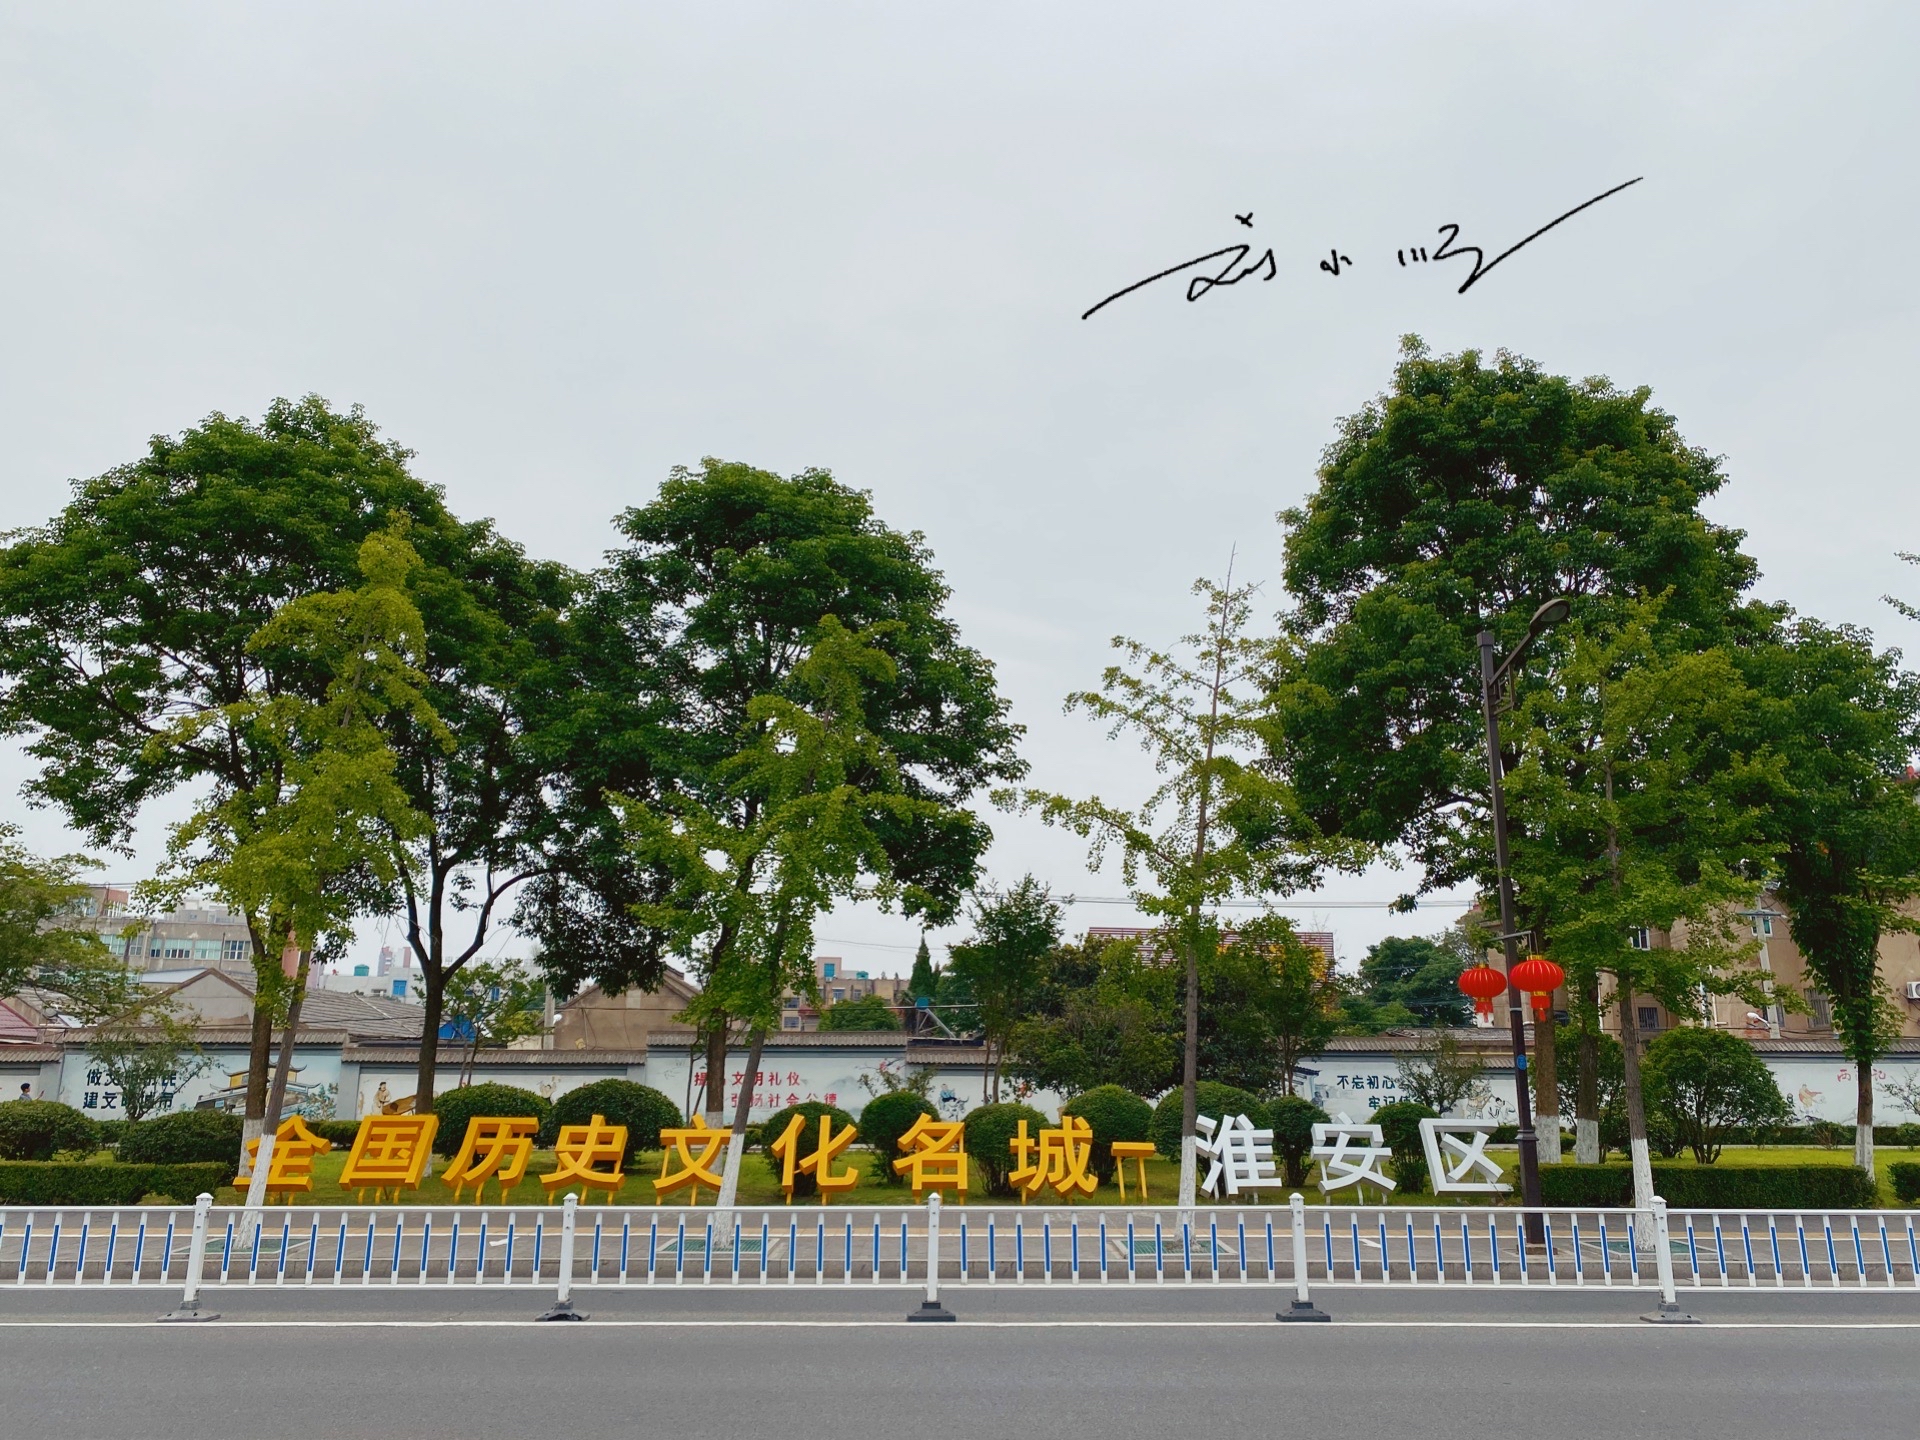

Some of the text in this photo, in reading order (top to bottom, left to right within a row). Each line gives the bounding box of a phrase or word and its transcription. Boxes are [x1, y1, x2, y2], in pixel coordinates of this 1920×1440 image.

[1837, 1068, 1886, 1081] 西记
[1336, 1075, 1396, 1090] 不忘初心
